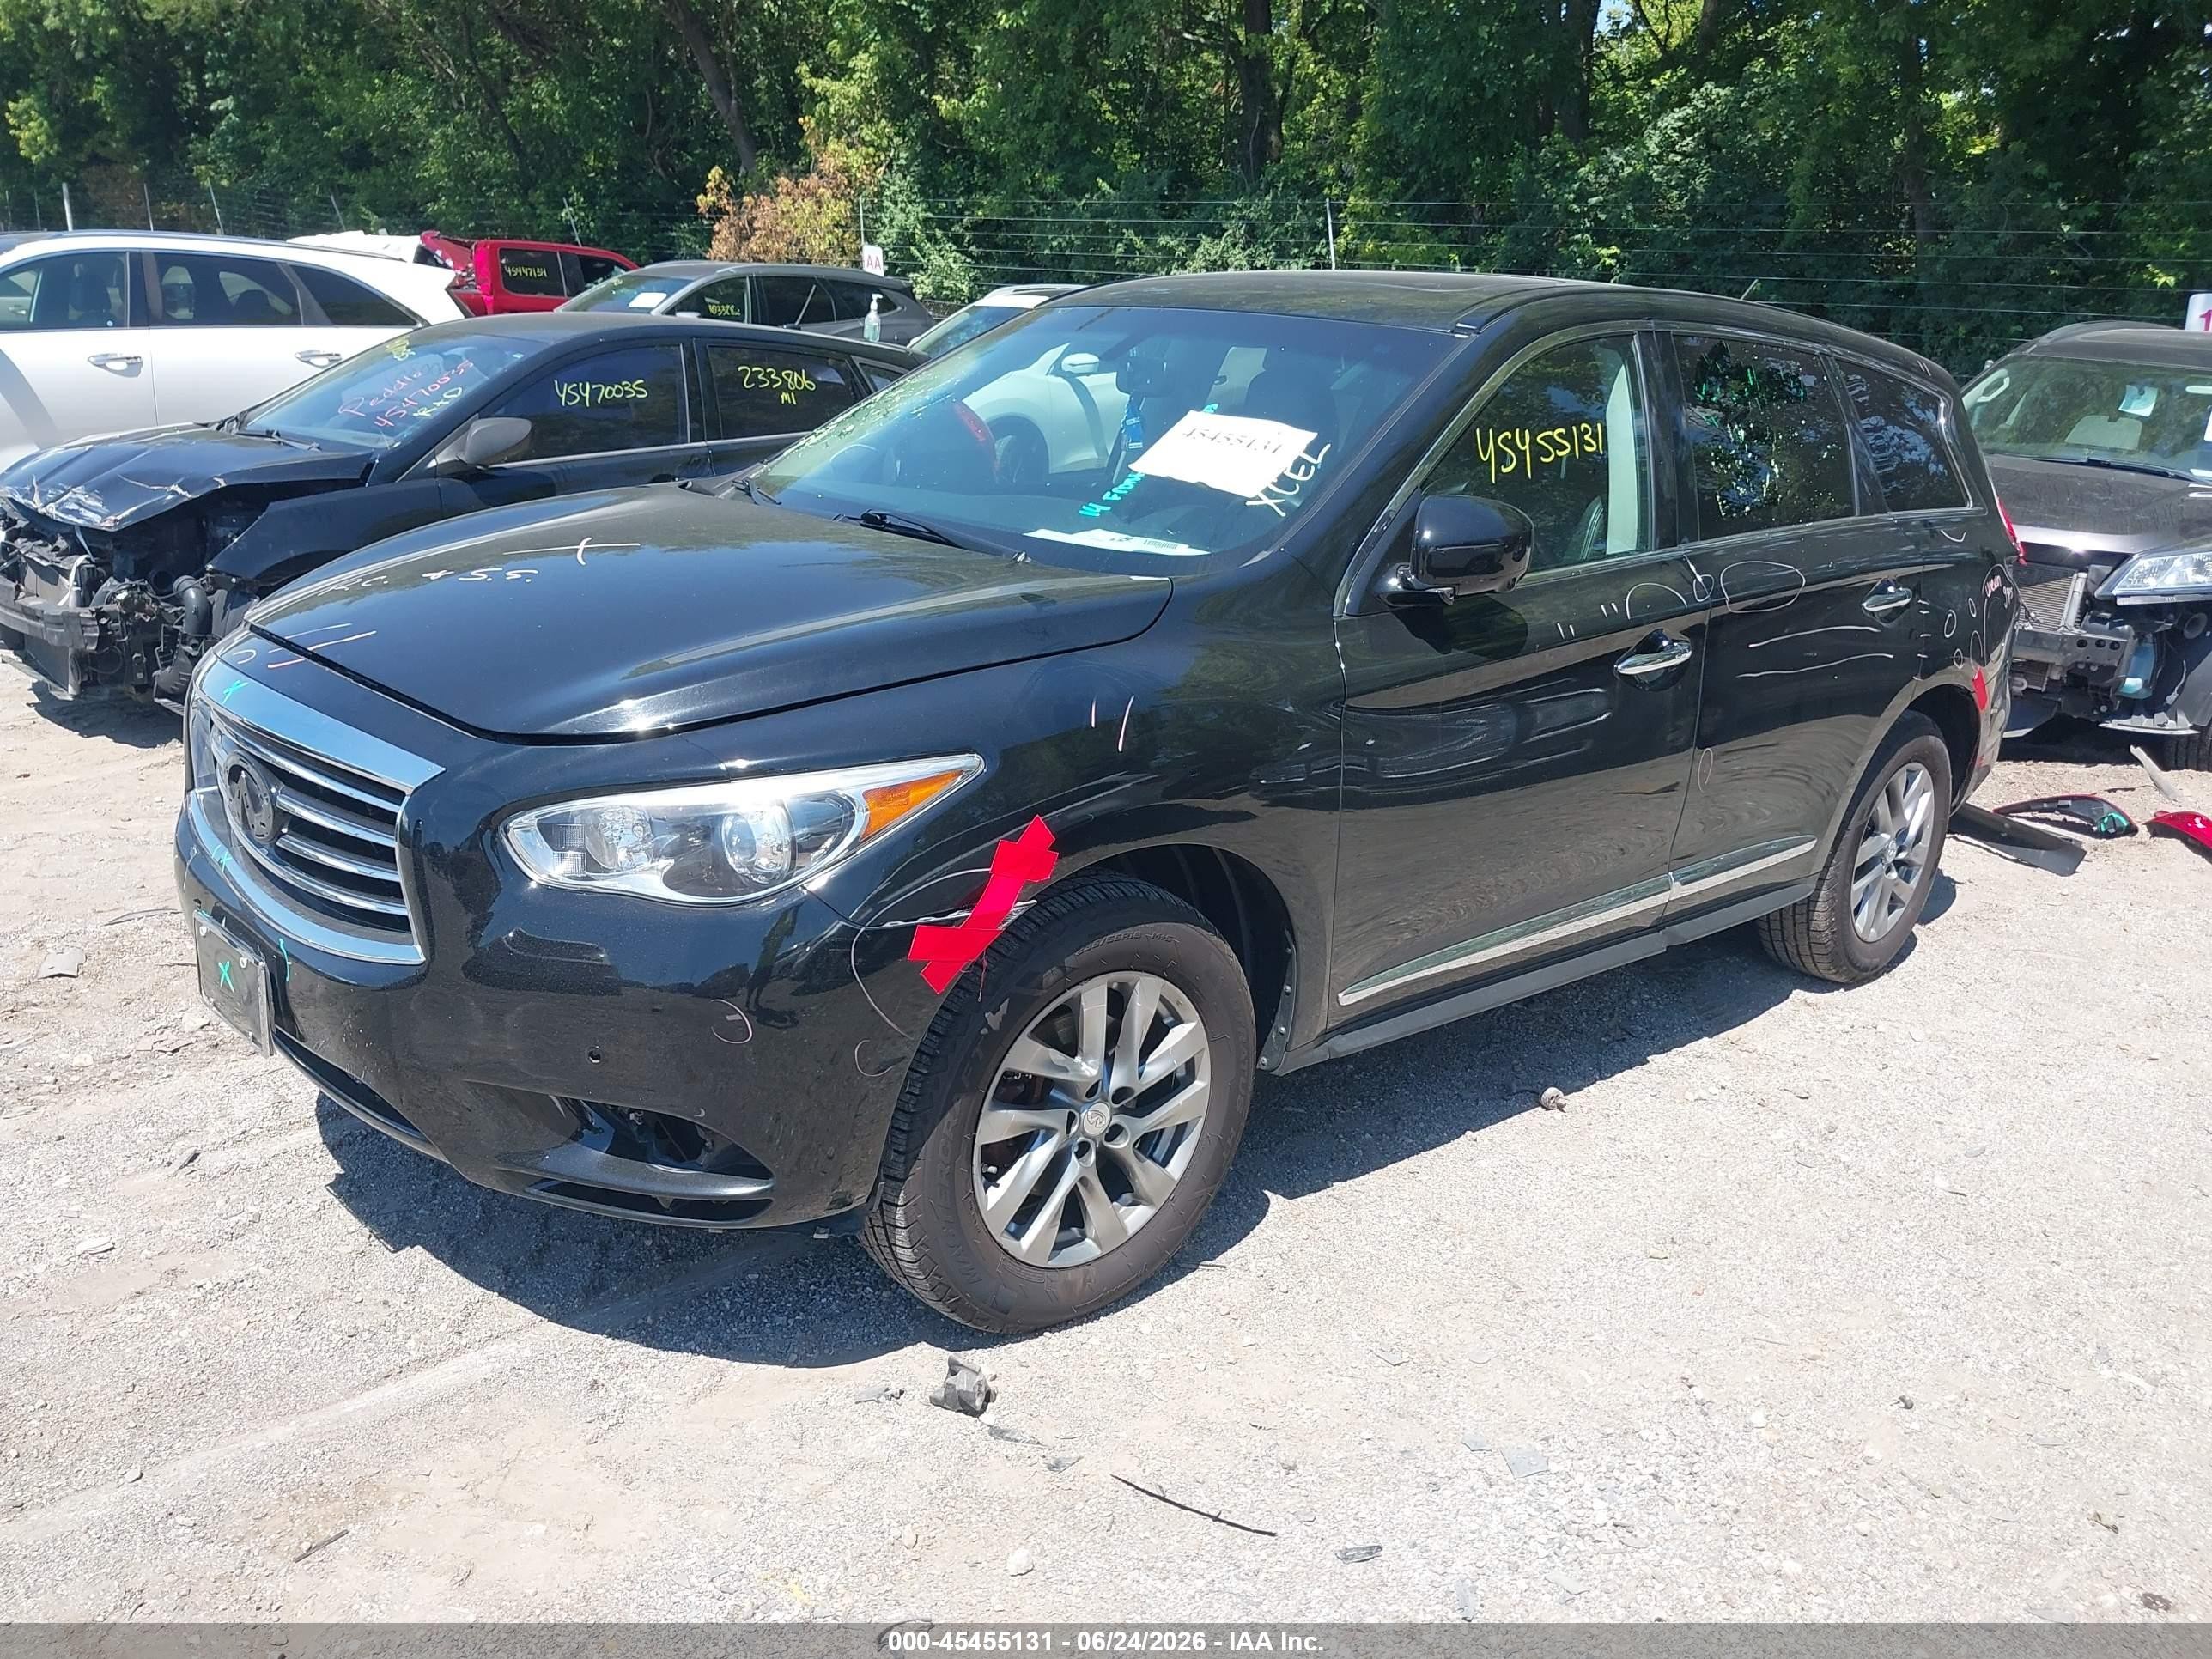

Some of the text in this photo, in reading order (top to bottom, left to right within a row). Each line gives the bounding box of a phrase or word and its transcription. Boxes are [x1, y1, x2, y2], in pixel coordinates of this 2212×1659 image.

[738, 366, 816, 391] 233806
[554, 380, 648, 407] 45470035
[1182, 428, 1284, 454] 45455131
[1476, 422, 1604, 484] 45455131
[1245, 443, 1332, 518] XCEL
